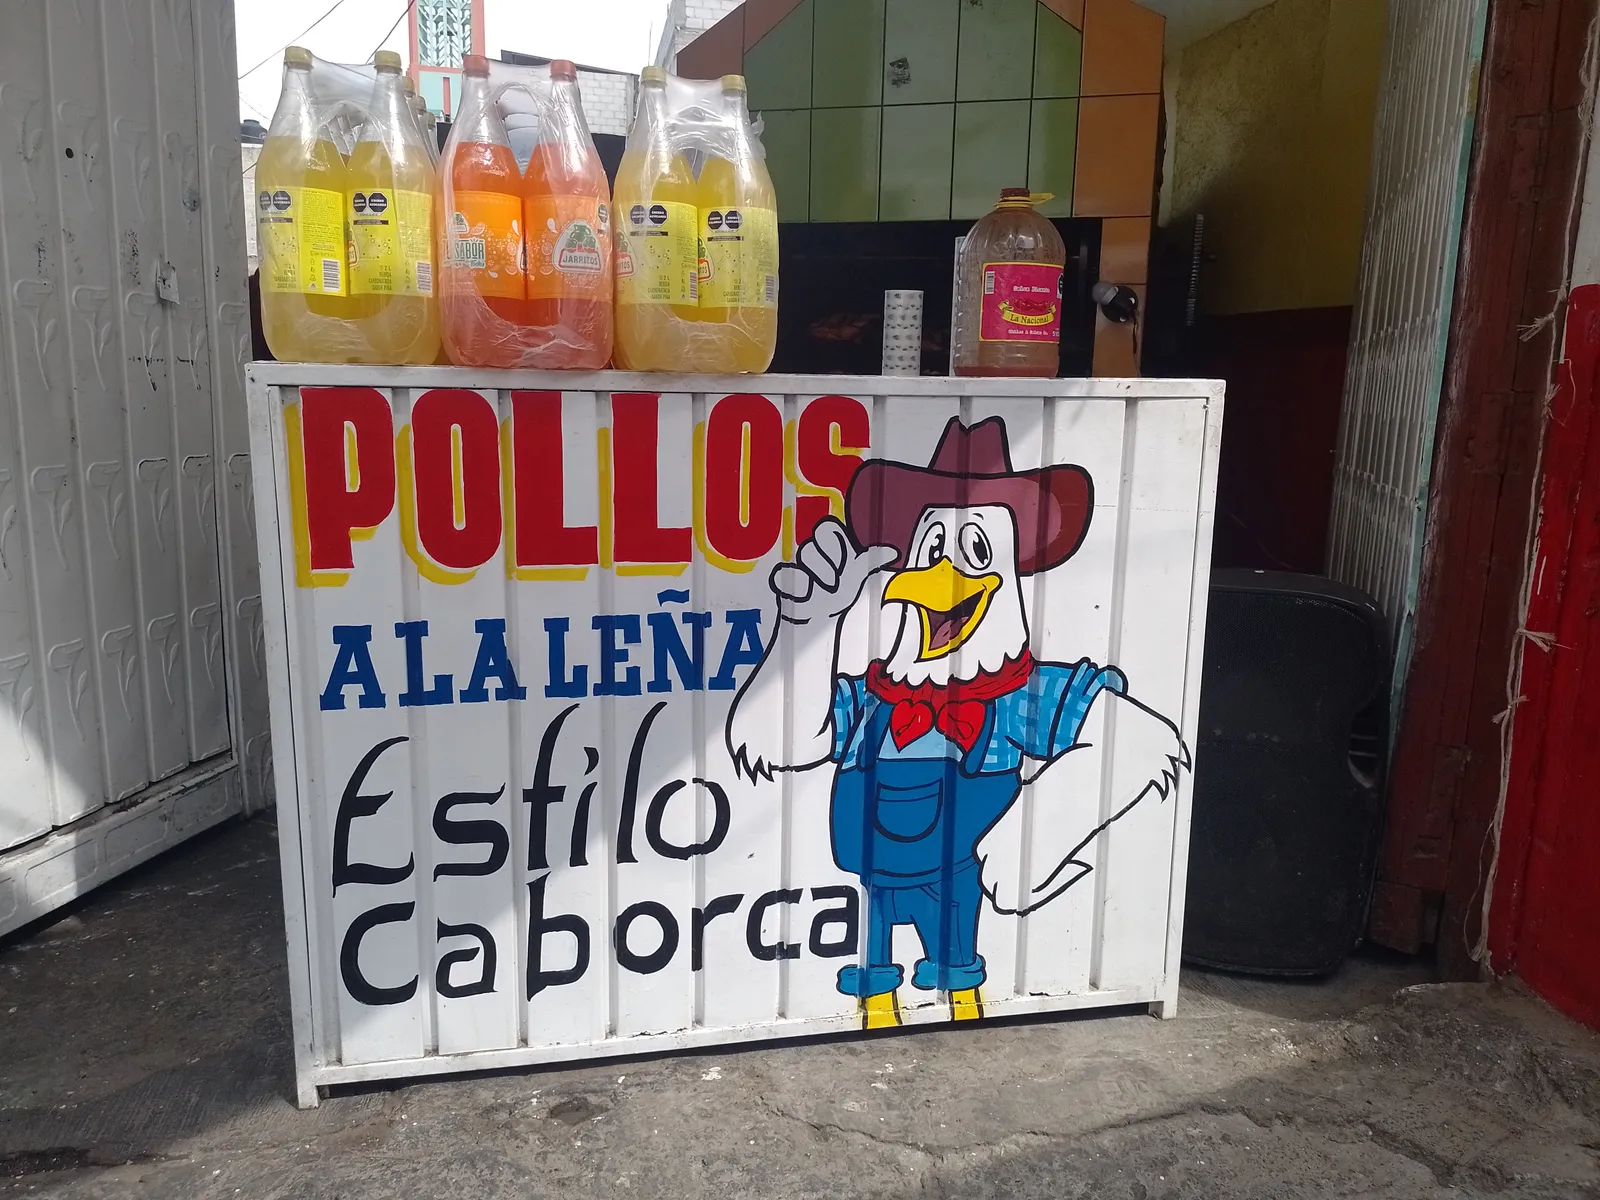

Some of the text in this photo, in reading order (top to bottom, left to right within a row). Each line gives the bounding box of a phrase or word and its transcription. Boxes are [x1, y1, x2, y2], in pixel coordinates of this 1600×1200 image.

[454, 242, 485, 260] SABOR
[562, 255, 598, 266] JARRITOS
[1010, 313, 1049, 325] La Nacional
[284, 387, 871, 589] POLLOS
[543, 588, 766, 700] LEÑA
[331, 698, 731, 899] Estilo
[339, 870, 860, 1004] Caborca
